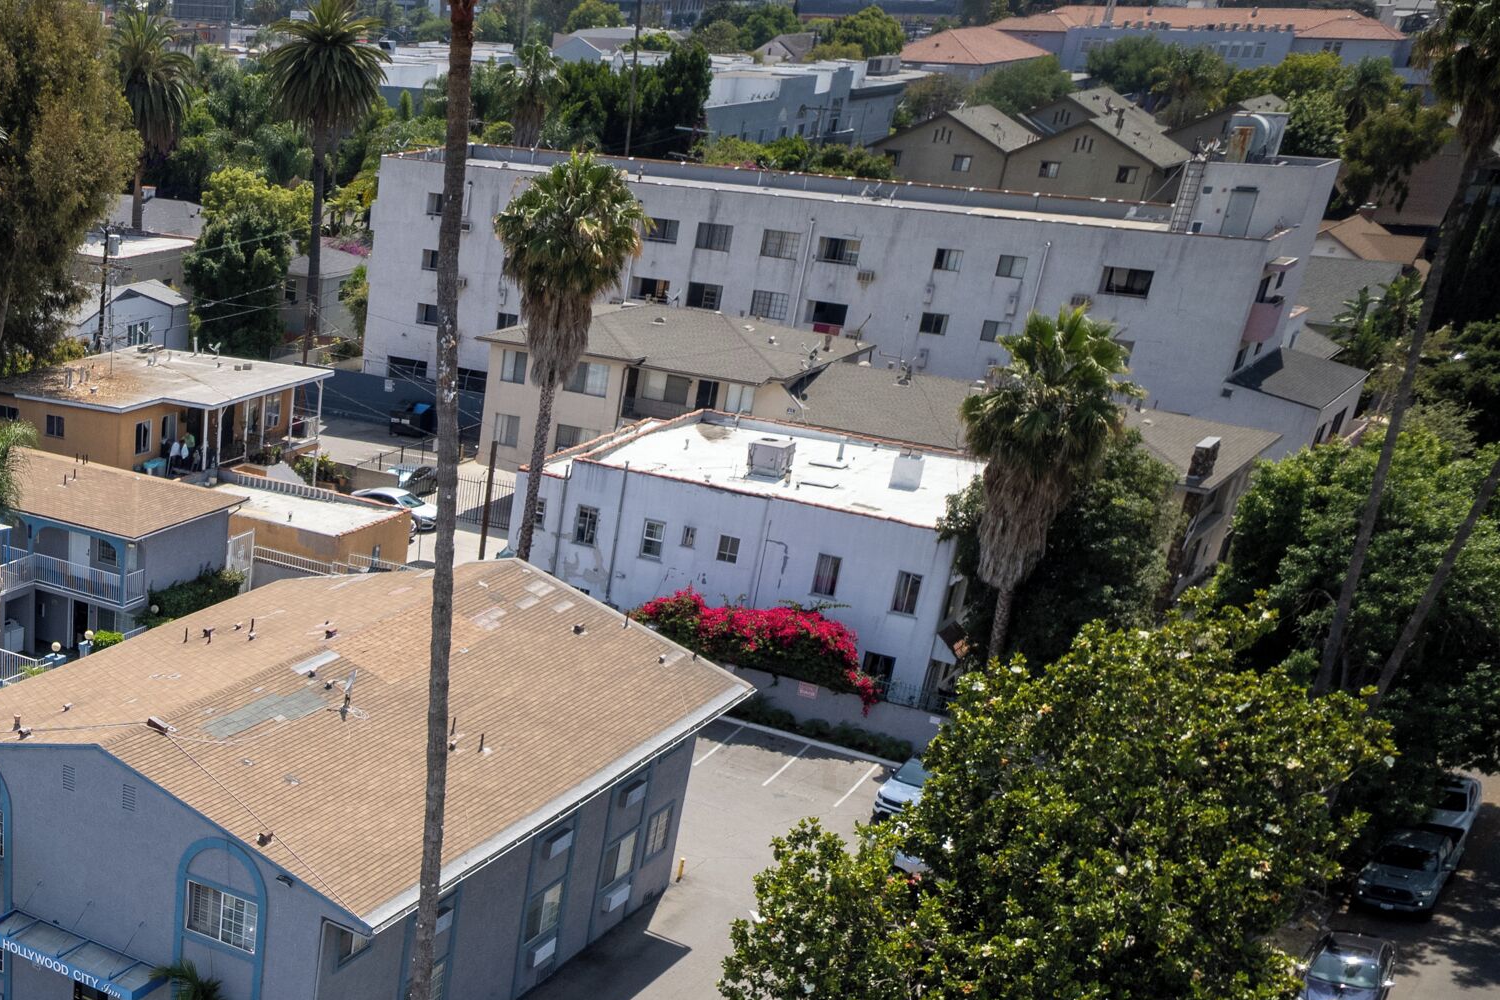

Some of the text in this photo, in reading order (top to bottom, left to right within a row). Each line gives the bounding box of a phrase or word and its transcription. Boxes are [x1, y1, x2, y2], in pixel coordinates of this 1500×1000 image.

[2, 938, 121, 999] HOLLYWOOD CITY Inn
